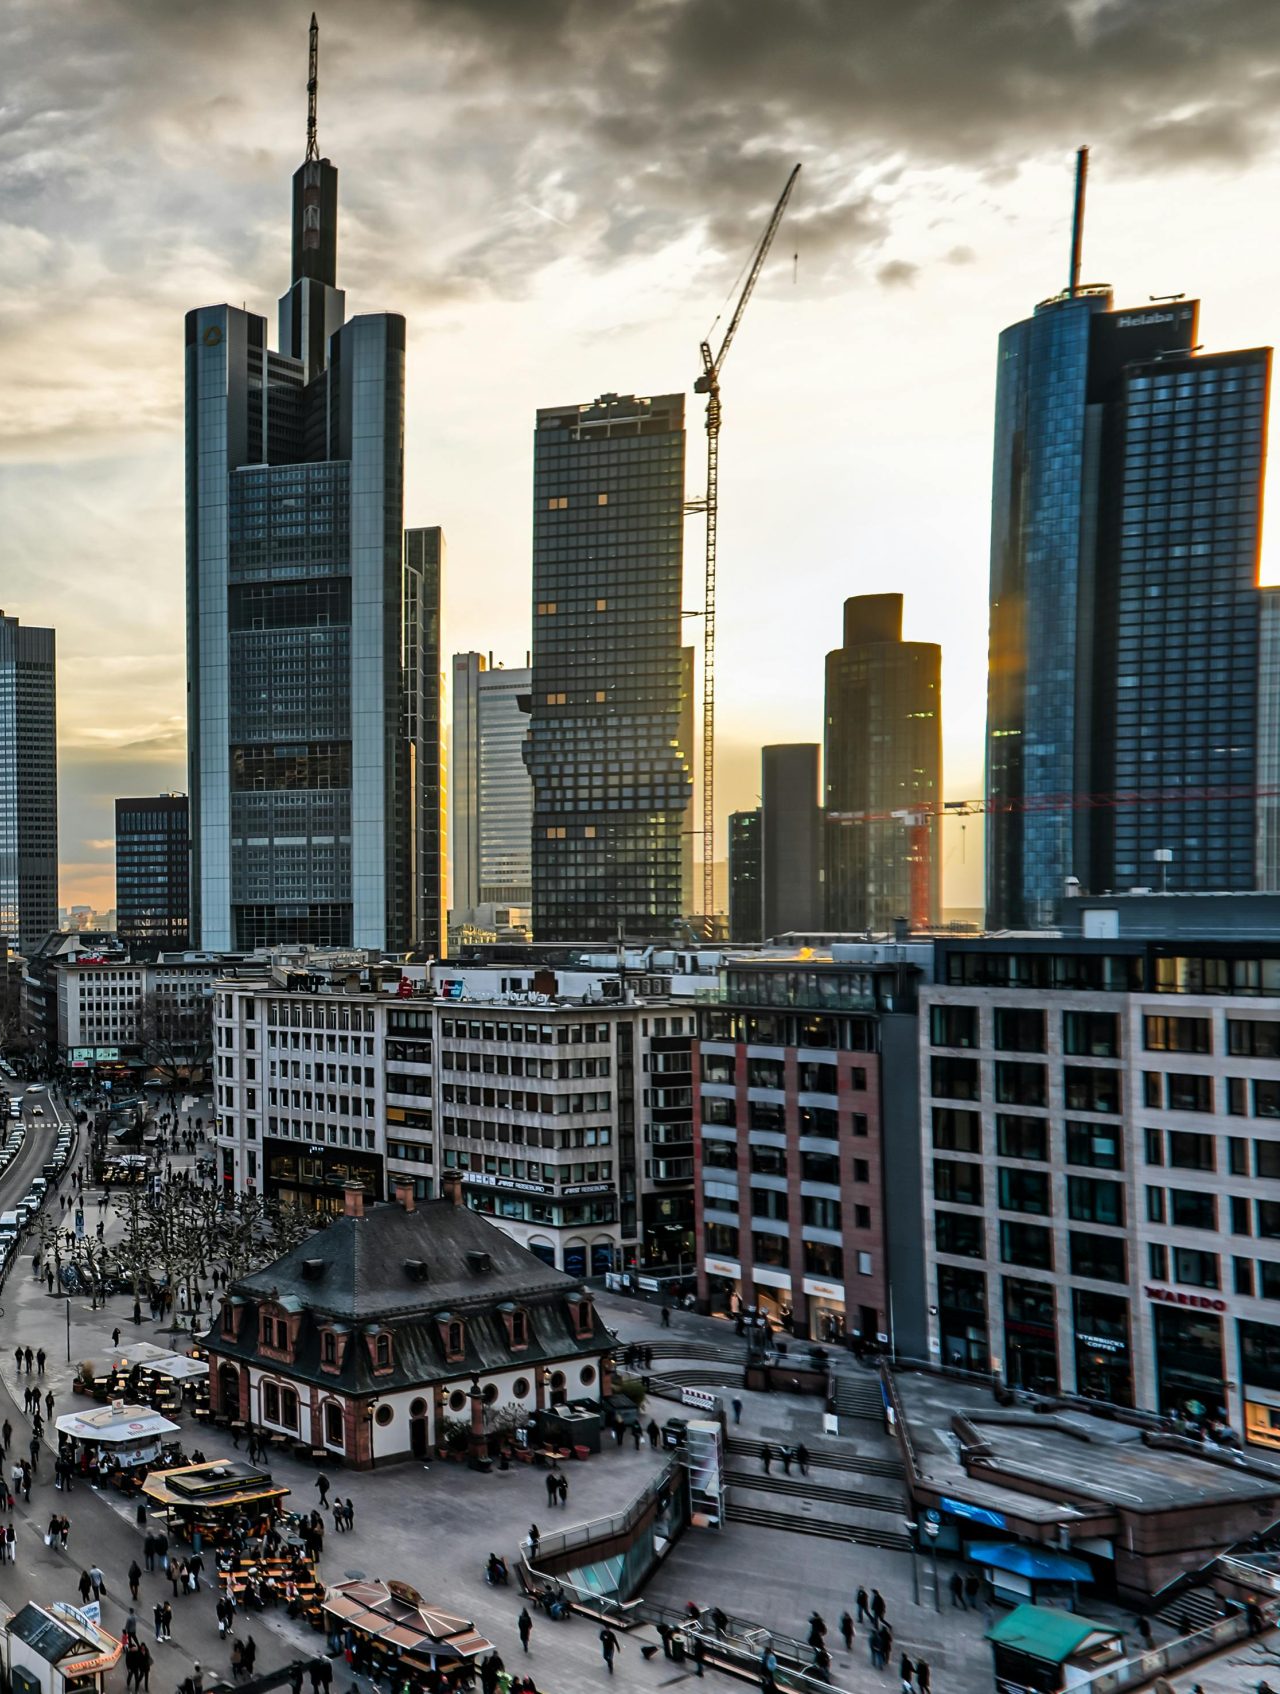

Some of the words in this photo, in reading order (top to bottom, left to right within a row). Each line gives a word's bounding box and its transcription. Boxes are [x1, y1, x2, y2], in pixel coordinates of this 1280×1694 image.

[1117, 312, 1174, 328] Helaba
[506, 990, 527, 1002] Your
[527, 990, 550, 1005] Way
[1144, 1285, 1227, 1312] MAREDO
[1076, 1333, 1125, 1348] STARBUCKS
[1086, 1341, 1117, 1352] COFFEE
